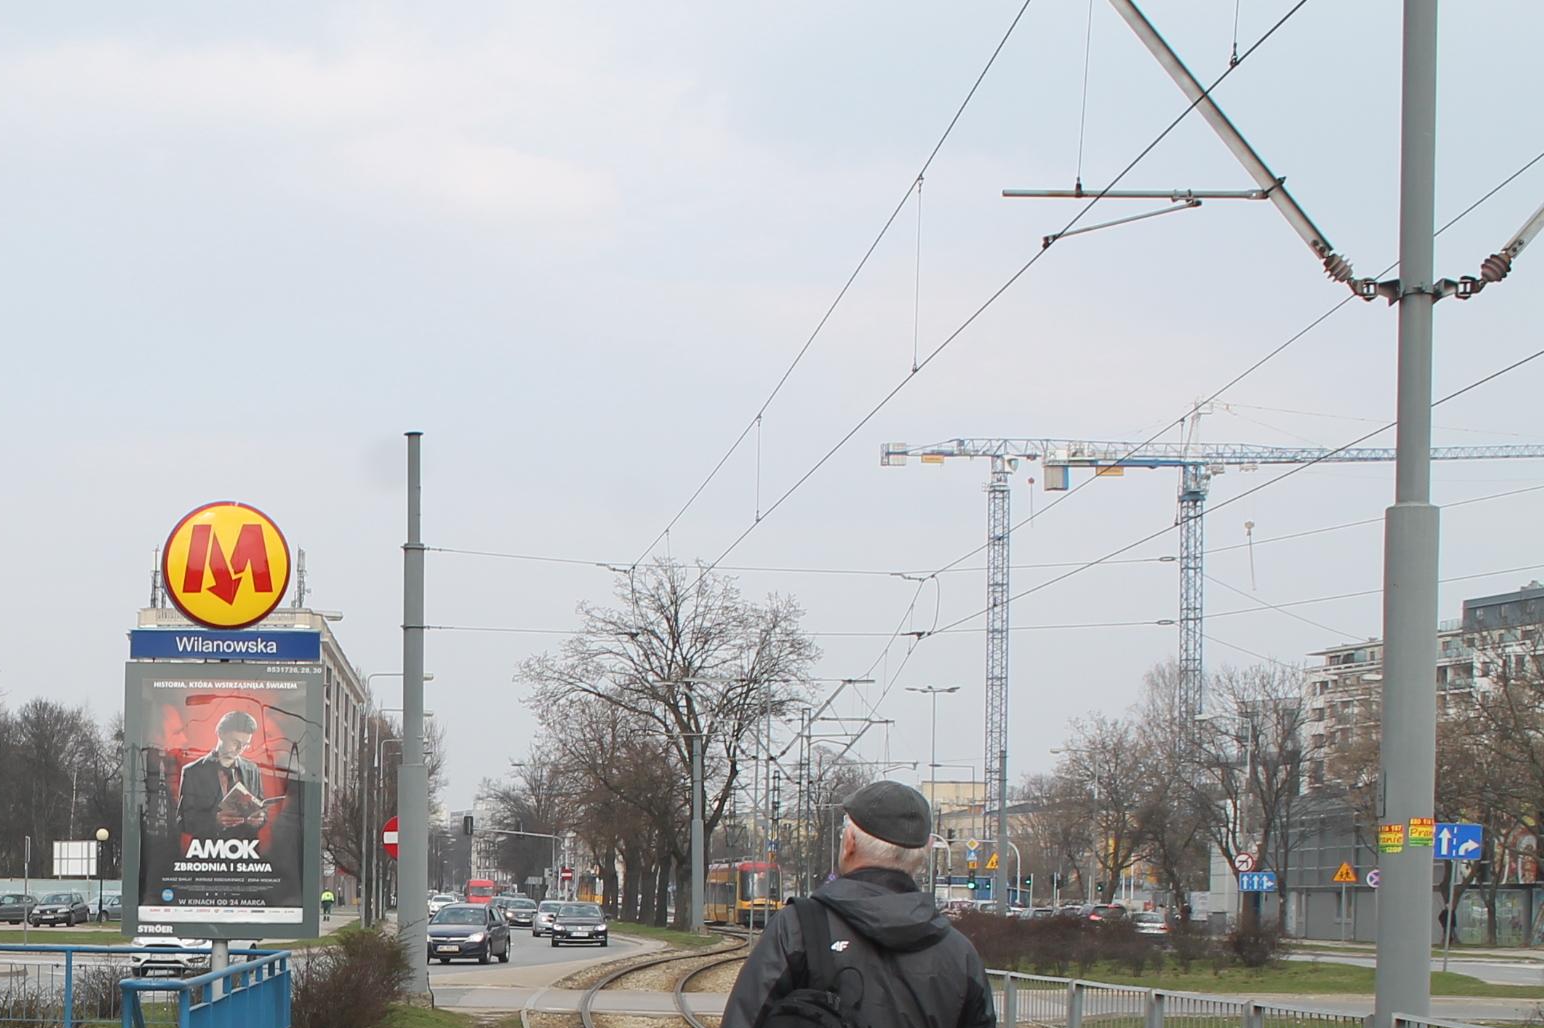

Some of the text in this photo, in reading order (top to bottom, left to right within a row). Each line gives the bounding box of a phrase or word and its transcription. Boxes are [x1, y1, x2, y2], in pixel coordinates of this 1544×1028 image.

[183, 524, 273, 606] M
[175, 636, 277, 654] Wilanowska
[189, 680, 213, 689] KTÓRA
[185, 839, 260, 859] AMOK
[173, 862, 272, 873] ZBRODNIA I SŁAWA
[240, 899, 266, 907] MARCA
[830, 940, 850, 952] 4F
